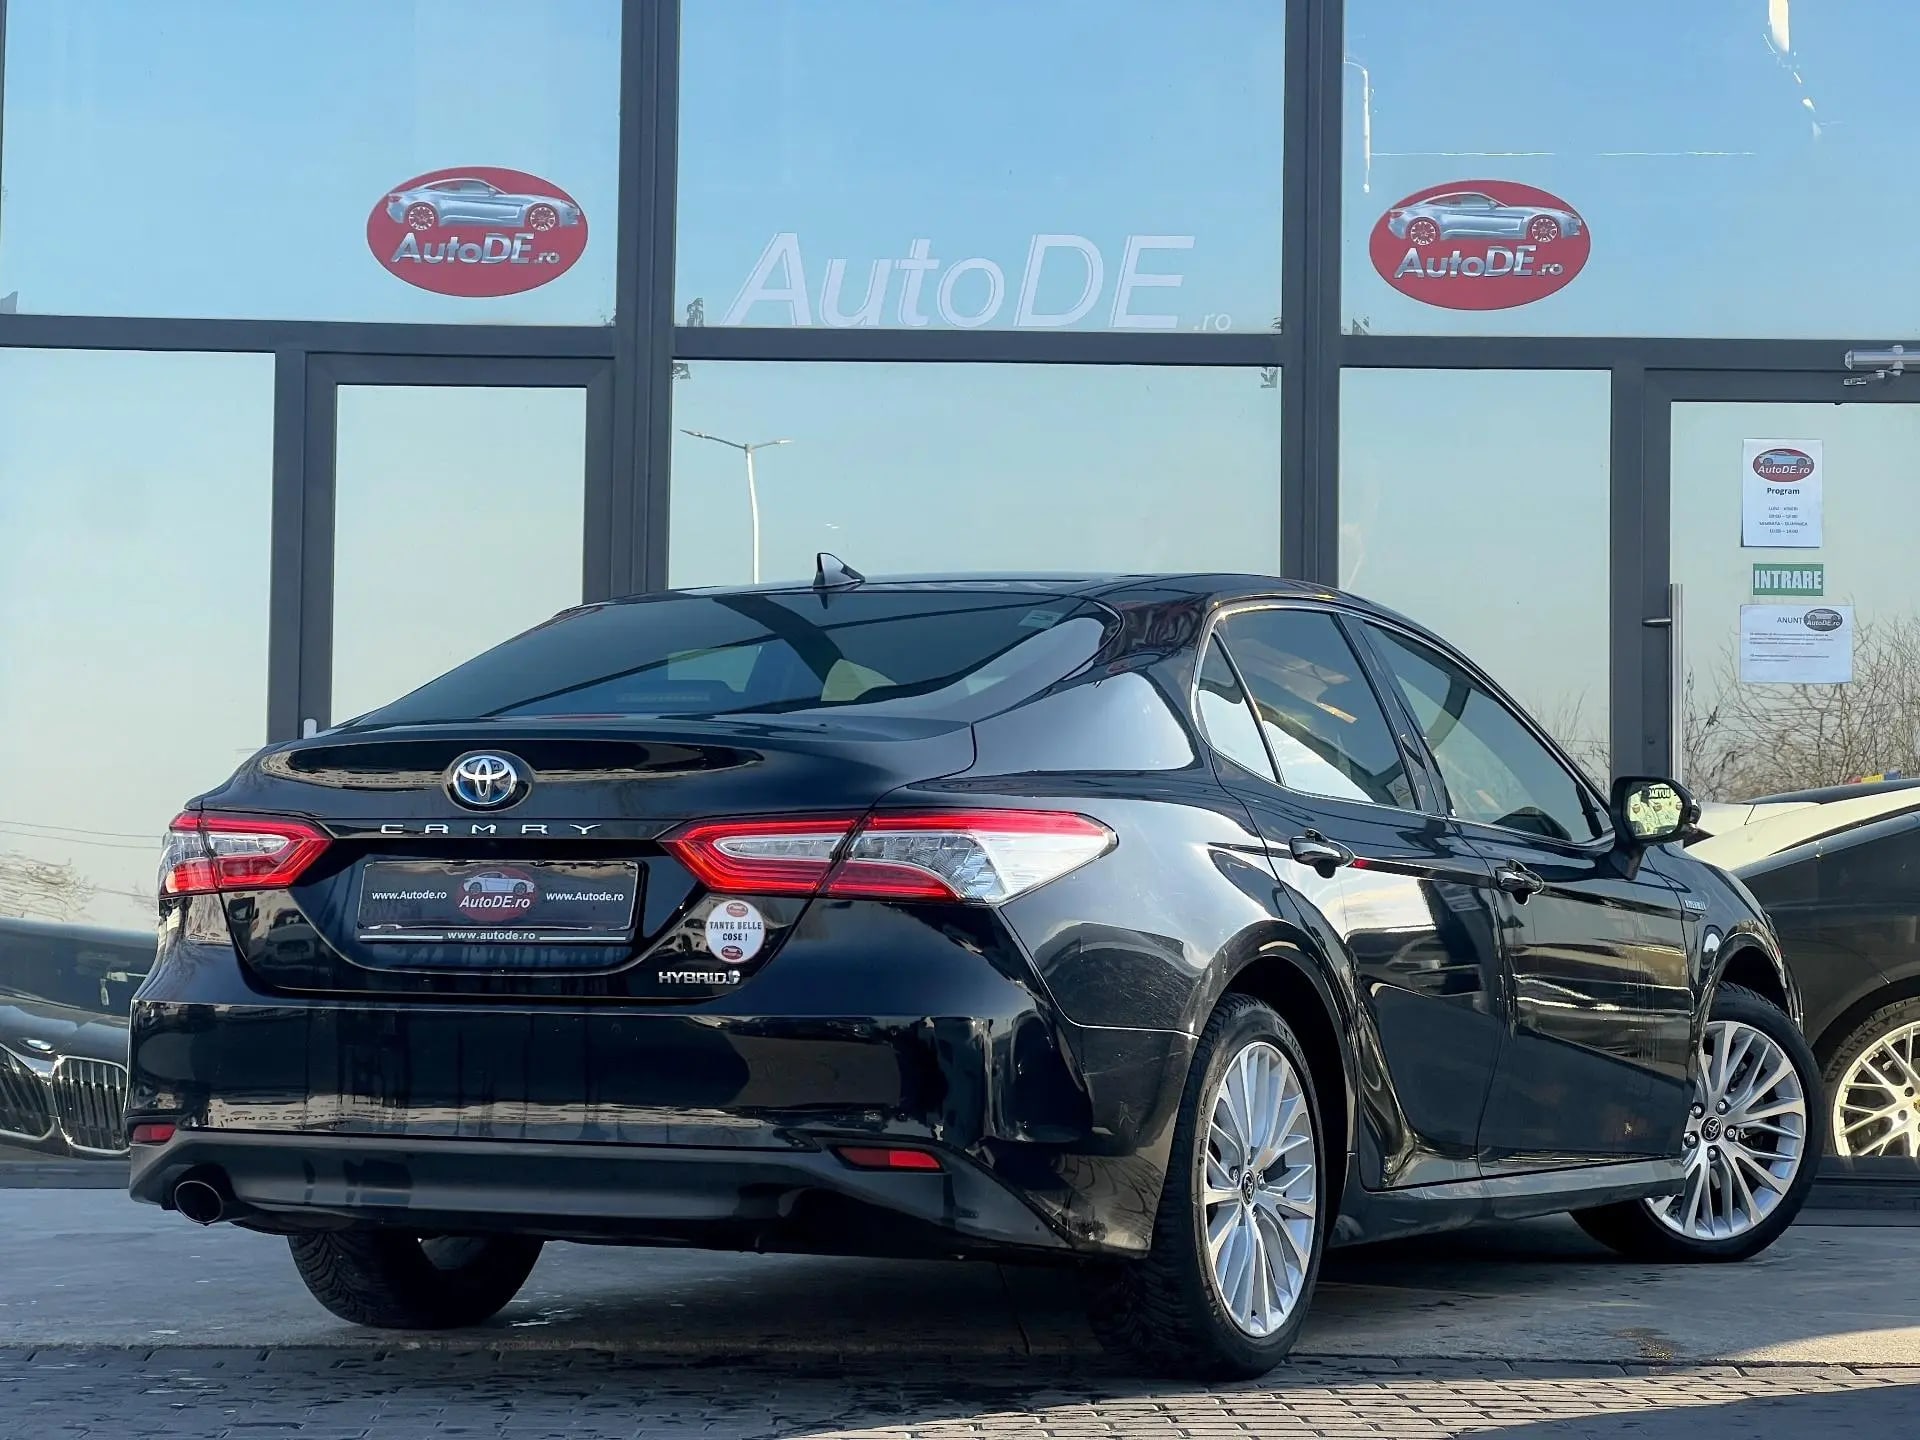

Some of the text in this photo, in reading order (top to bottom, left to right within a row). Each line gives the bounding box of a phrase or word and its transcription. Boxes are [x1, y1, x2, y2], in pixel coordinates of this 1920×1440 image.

[1757, 465, 1811, 475] AutoDE.ro
[1766, 487, 1800, 496] Program
[1754, 570, 1822, 589] INTRARE
[380, 824, 601, 835] CAMRY
[371, 890, 447, 900] www.Autode.ro
[546, 891, 625, 902] www.Autode.ro
[459, 896, 531, 909] AutoDE.ro
[709, 921, 735, 930] TANTE
[447, 930, 536, 942] www.autode.ro
[722, 933, 743, 941] COSE
